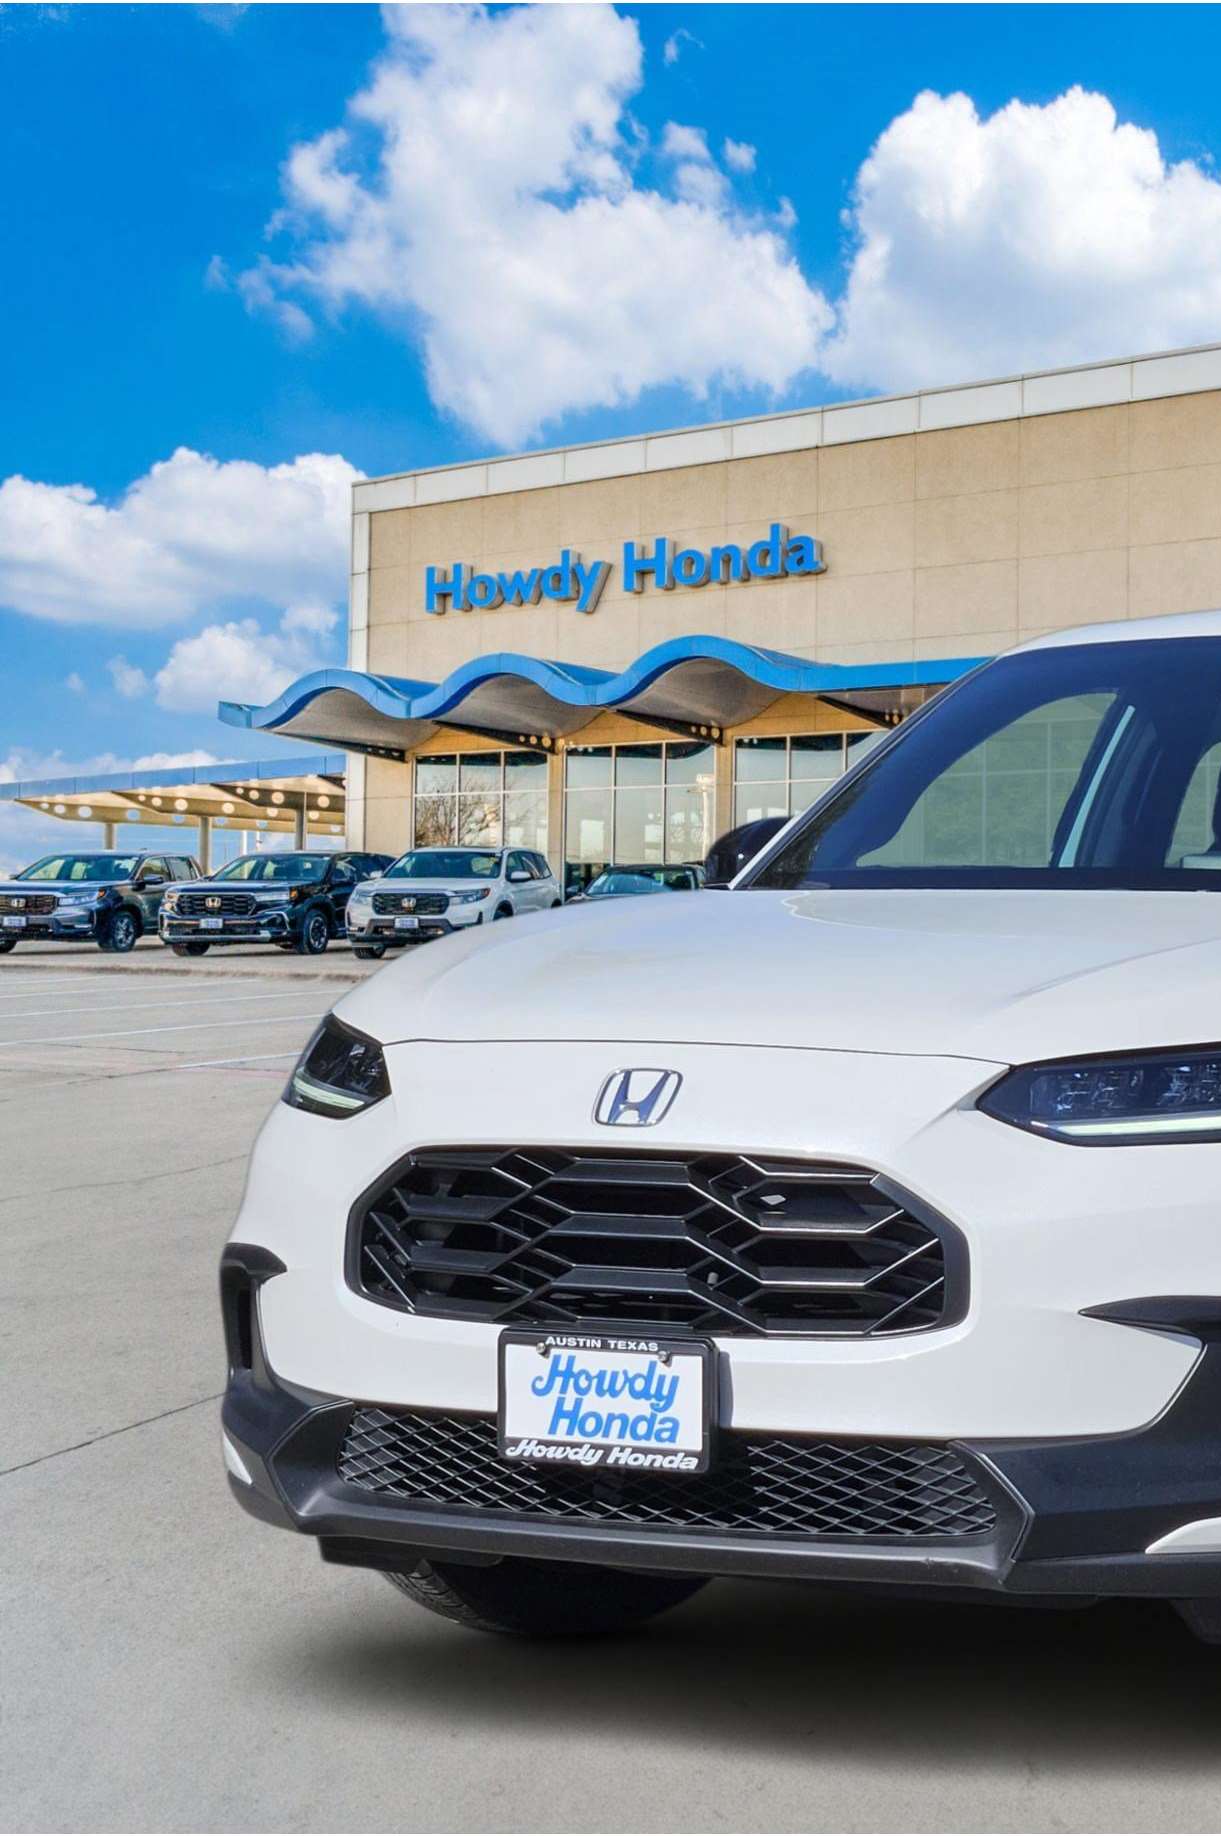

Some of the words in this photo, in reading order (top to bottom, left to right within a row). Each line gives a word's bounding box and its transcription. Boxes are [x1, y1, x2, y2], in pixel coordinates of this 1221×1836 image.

[425, 549, 611, 615] Howdy
[623, 523, 827, 593] Honda
[545, 1336, 601, 1349] AUSTIN
[608, 1340, 659, 1352] TEXAS
[531, 1354, 680, 1413] Howdy
[547, 1397, 680, 1444] Honda
[505, 1439, 603, 1466] Howdy
[607, 1446, 699, 1470] Honda
